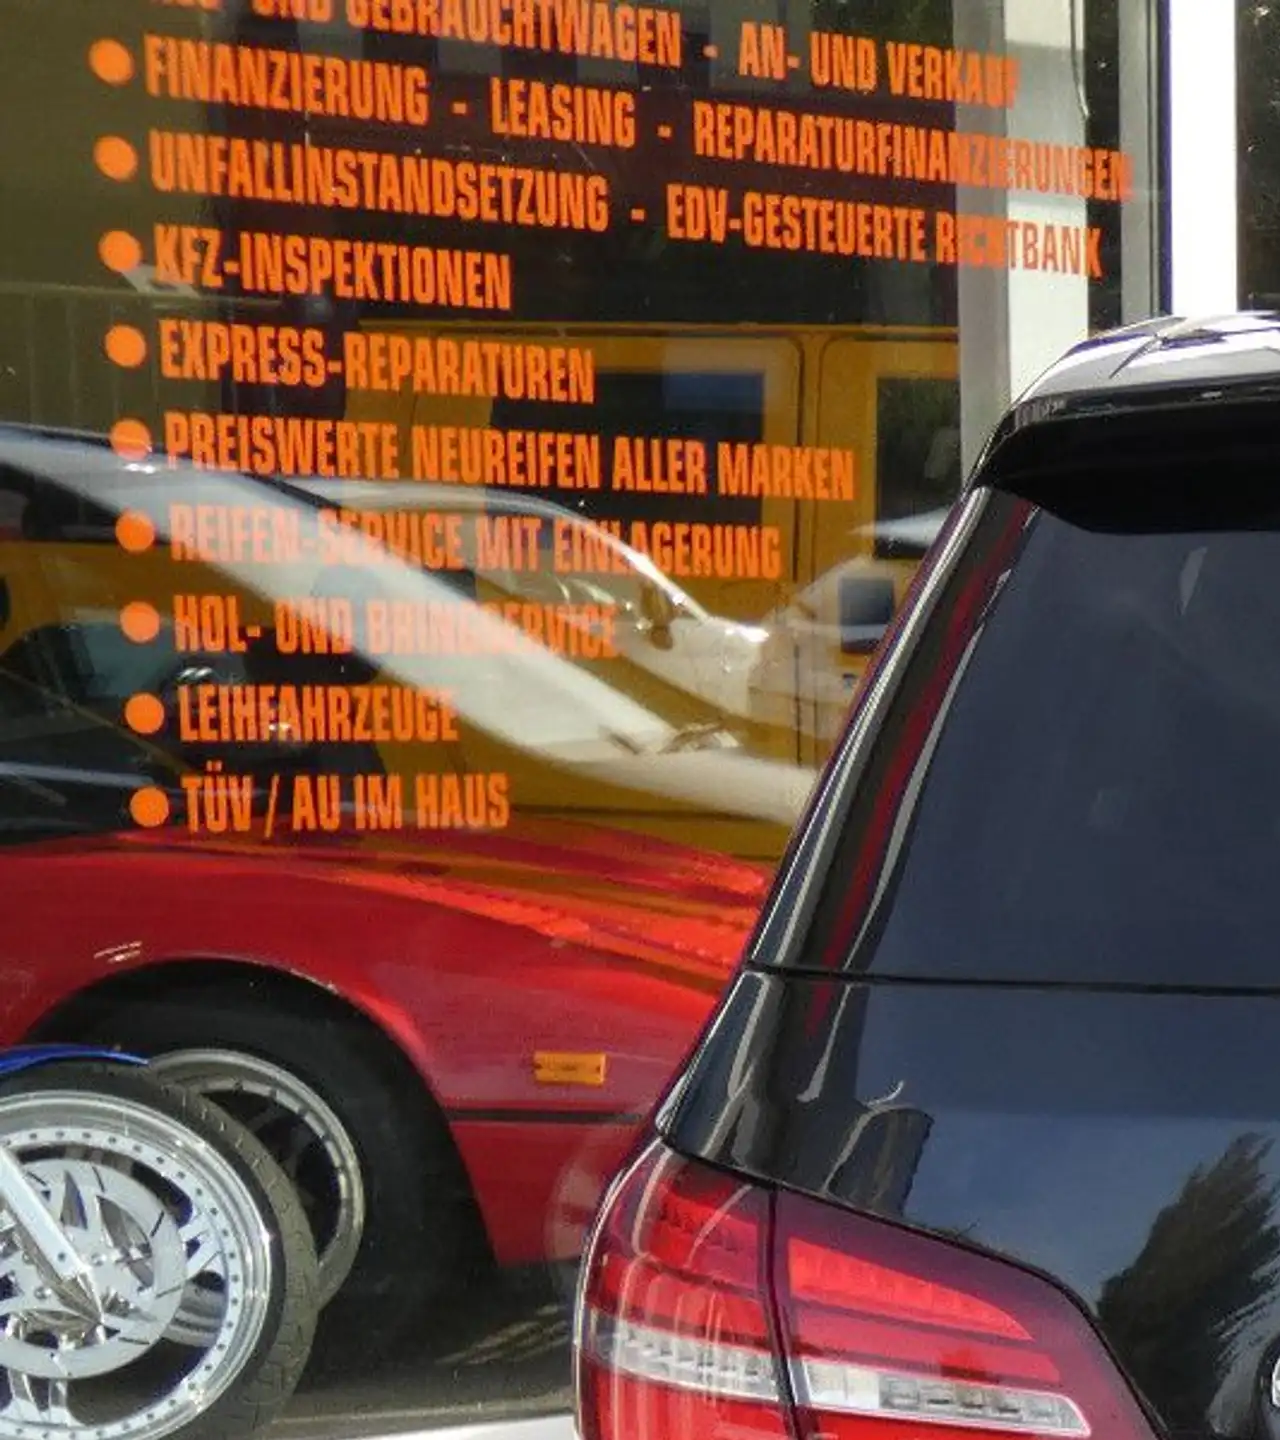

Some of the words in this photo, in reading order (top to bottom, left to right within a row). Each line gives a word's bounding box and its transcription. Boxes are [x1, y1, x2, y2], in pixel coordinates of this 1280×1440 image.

[809, 32, 876, 92] UND
[886, 41, 1020, 110] VERKAUF
[143, 33, 429, 126] FINANZIERUNG
[491, 76, 636, 148] LEASING
[693, 100, 1134, 203] REPARATURFINANZIERUNGEN
[149, 131, 609, 233] UNFALLINSTANDSETZUNG
[667, 183, 926, 262] EDV-GESTEUERTE
[153, 223, 512, 310] KFZ-INSPEKTIONEN
[159, 319, 595, 405] EXPRESS-REPARATUREN
[164, 411, 400, 479] PREISWERTE
[411, 425, 600, 489] NEUREIFEN
[612, 436, 706, 494] ALLER
[717, 442, 856, 501] MARKEN
[169, 504, 465, 571] REIFEN-SERVICE
[474, 514, 542, 572] MIT
[553, 516, 782, 580] EINLAGERUNG
[173, 594, 262, 652] HOL-
[275, 600, 354, 654] UND
[177, 683, 460, 743] LEIHFAHRZEUGE
[181, 760, 253, 833] TÜV
[292, 774, 341, 832] AU
[354, 772, 402, 831] IM
[414, 772, 511, 831] HAUS
